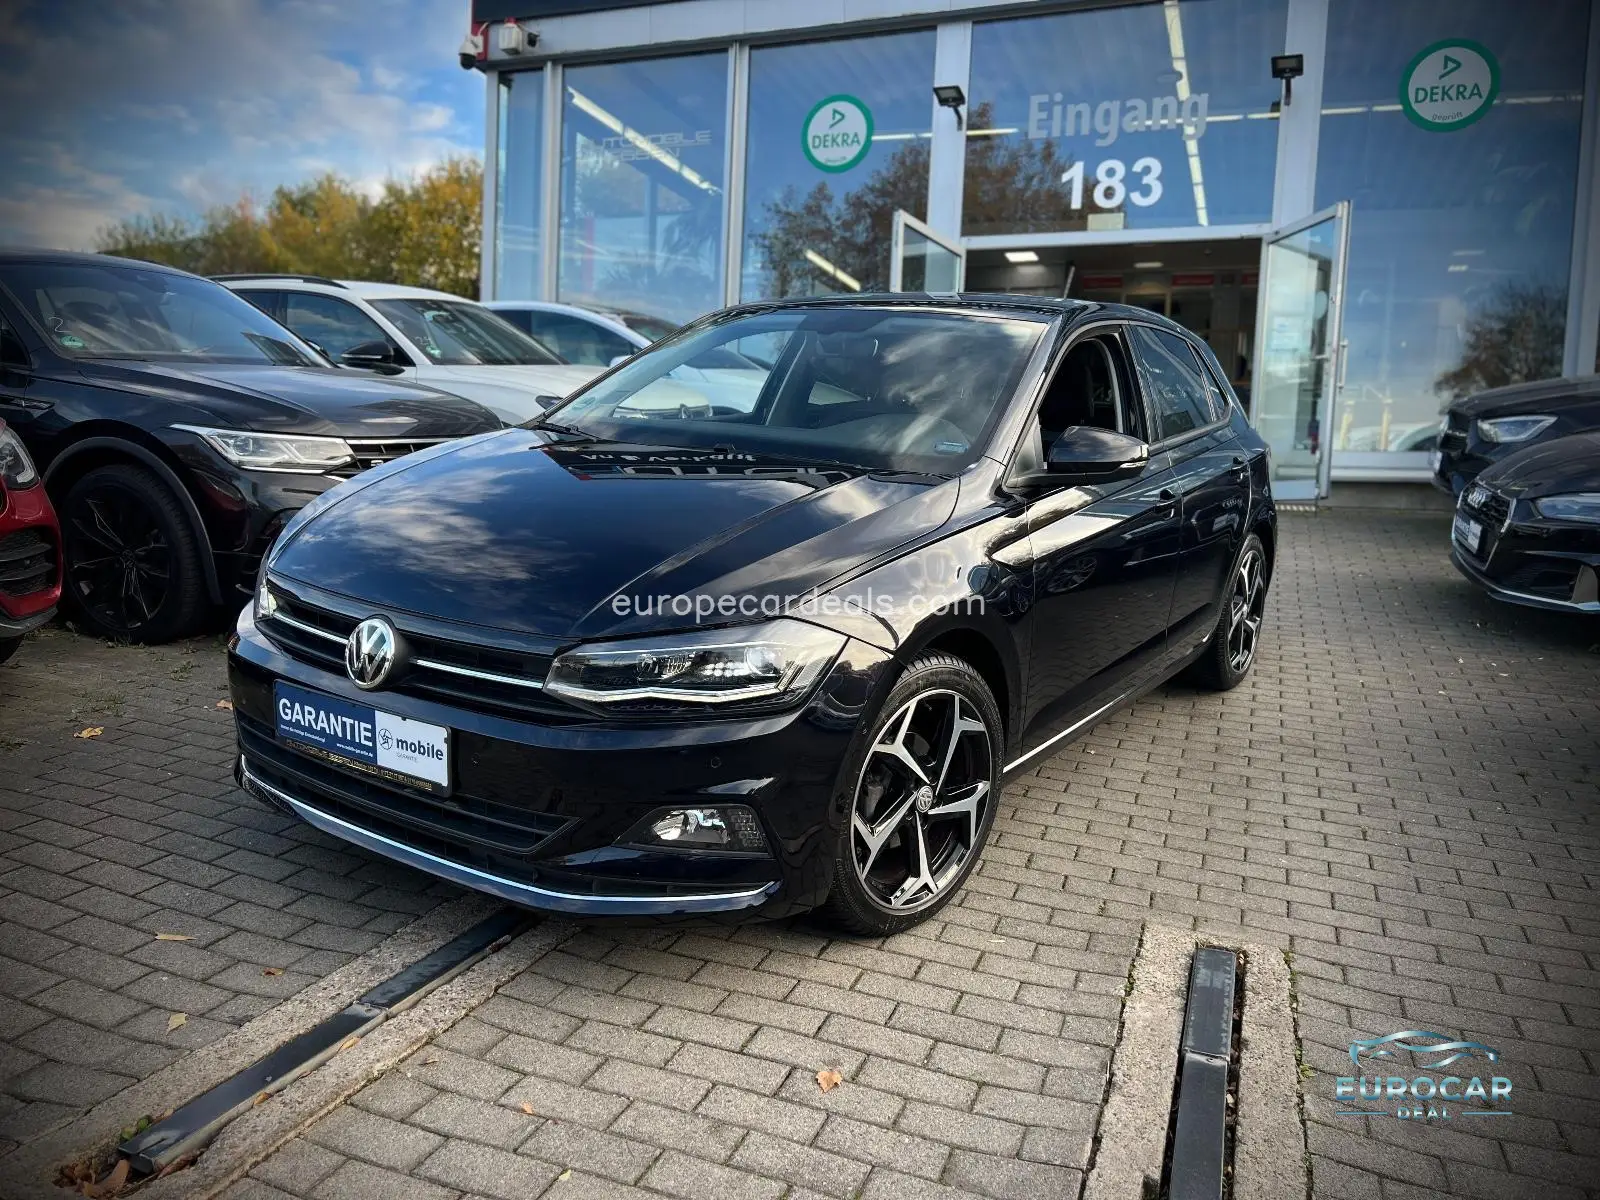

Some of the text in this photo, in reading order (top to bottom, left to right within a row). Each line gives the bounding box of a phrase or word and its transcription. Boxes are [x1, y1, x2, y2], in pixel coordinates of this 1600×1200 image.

[1414, 82, 1483, 104] DEKRA
[1028, 92, 1209, 147] Eingang
[811, 131, 860, 149] DEKRA
[1061, 157, 1163, 210] 183
[279, 698, 373, 747] GARANTIE
[396, 737, 444, 761] mobile
